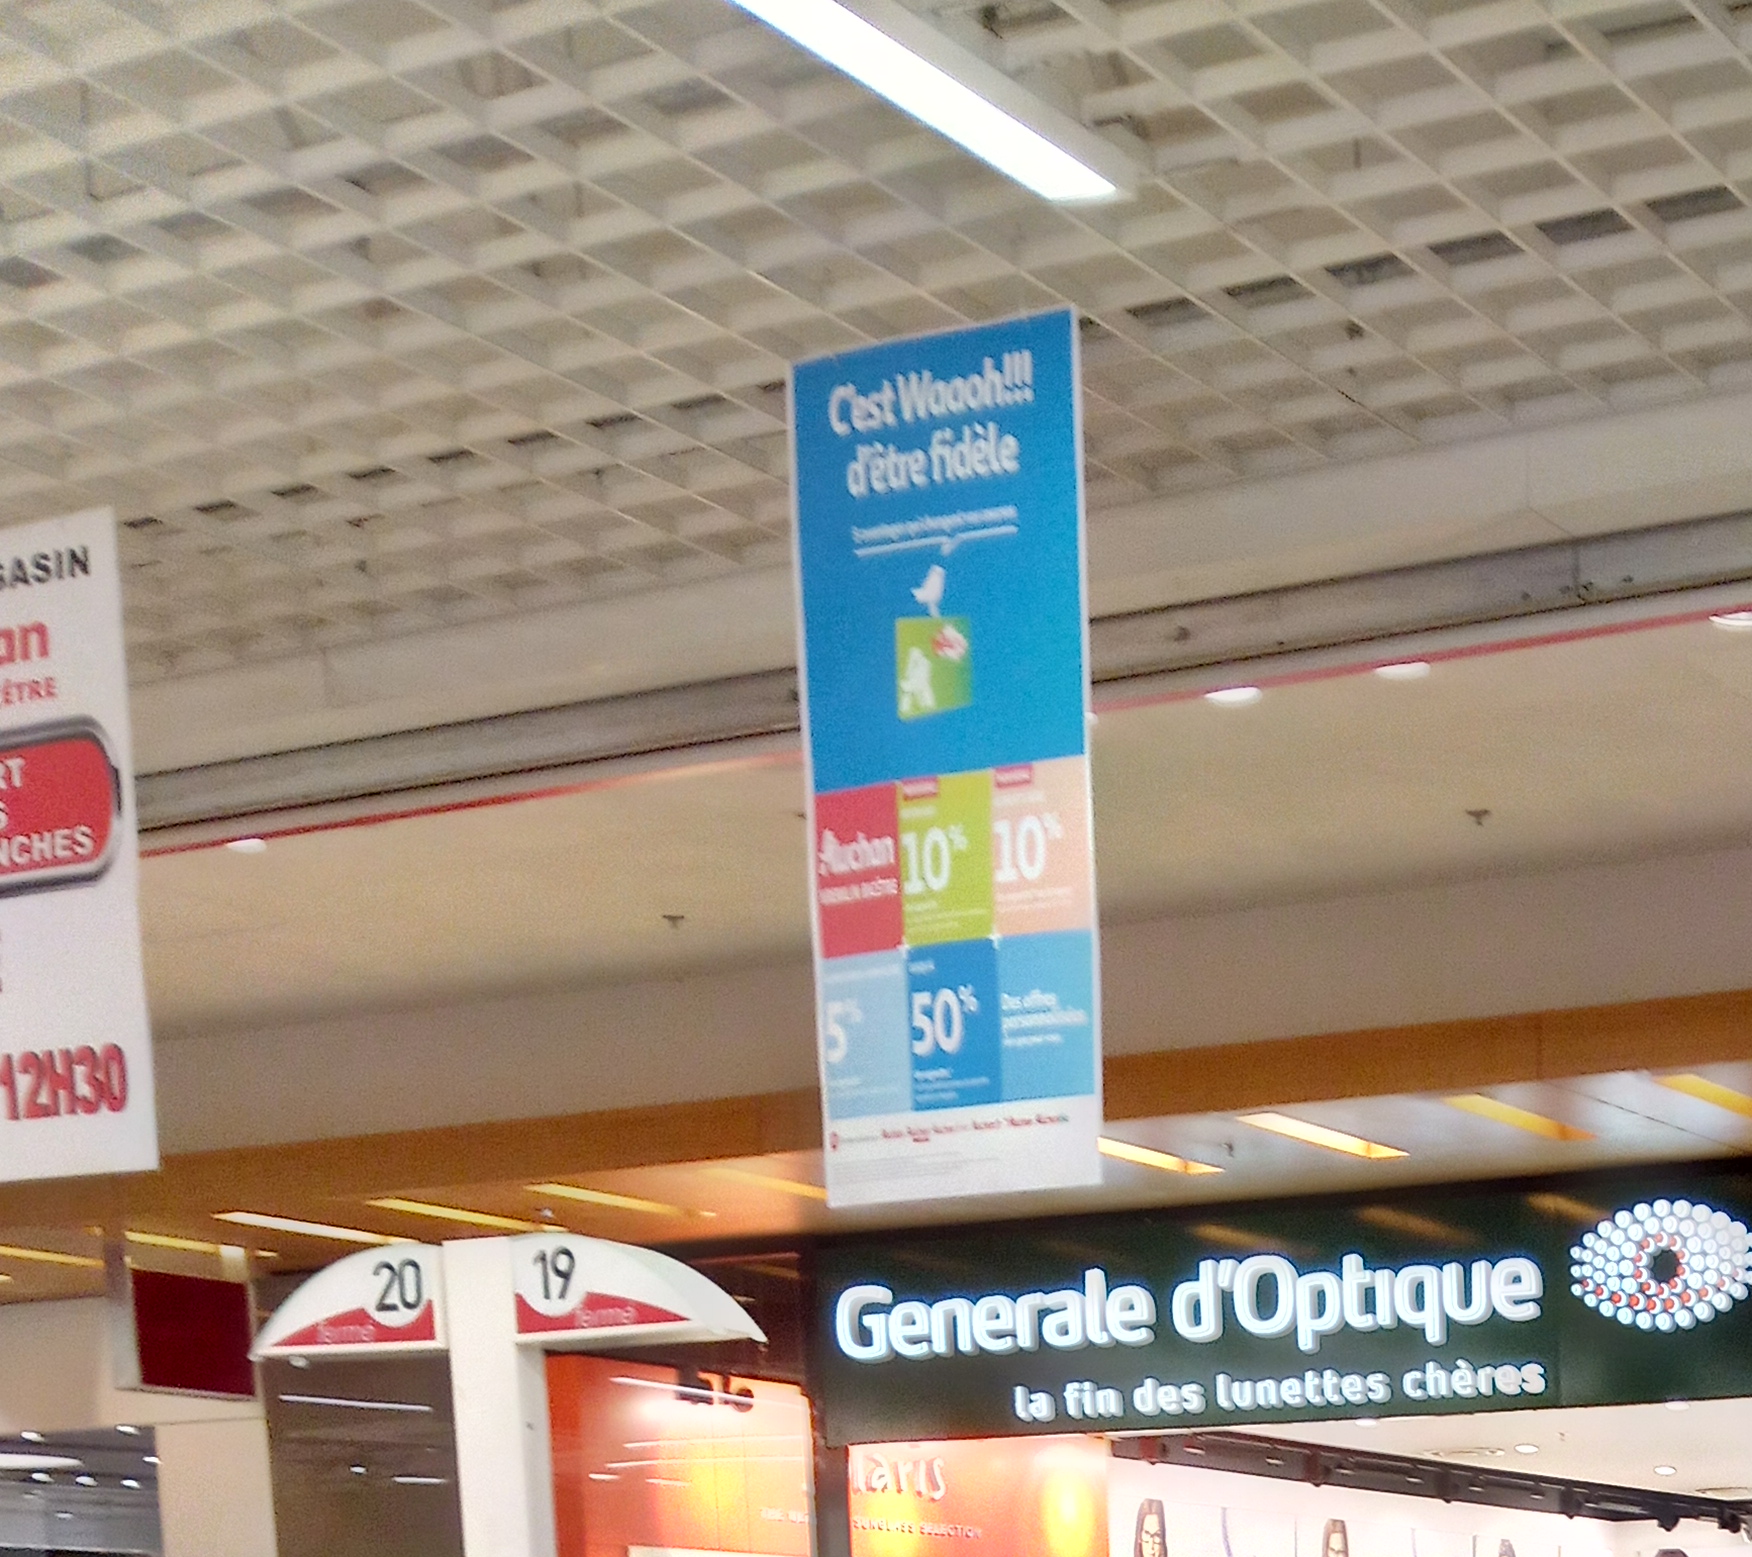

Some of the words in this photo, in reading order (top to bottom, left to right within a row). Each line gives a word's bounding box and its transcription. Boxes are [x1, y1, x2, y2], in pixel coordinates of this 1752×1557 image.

[929, 420, 1020, 484] fidèle
[373, 1258, 421, 1311] 20
[534, 1245, 576, 1300] 19
[834, 1266, 1156, 1362] Generale
[1172, 1252, 1542, 1355] d'Optique
[1012, 1385, 1055, 1422] la
[1064, 1382, 1122, 1421] fin
[1133, 1377, 1203, 1416] des
[1216, 1371, 1391, 1410] lunettes
[1402, 1359, 1546, 1399] chères
